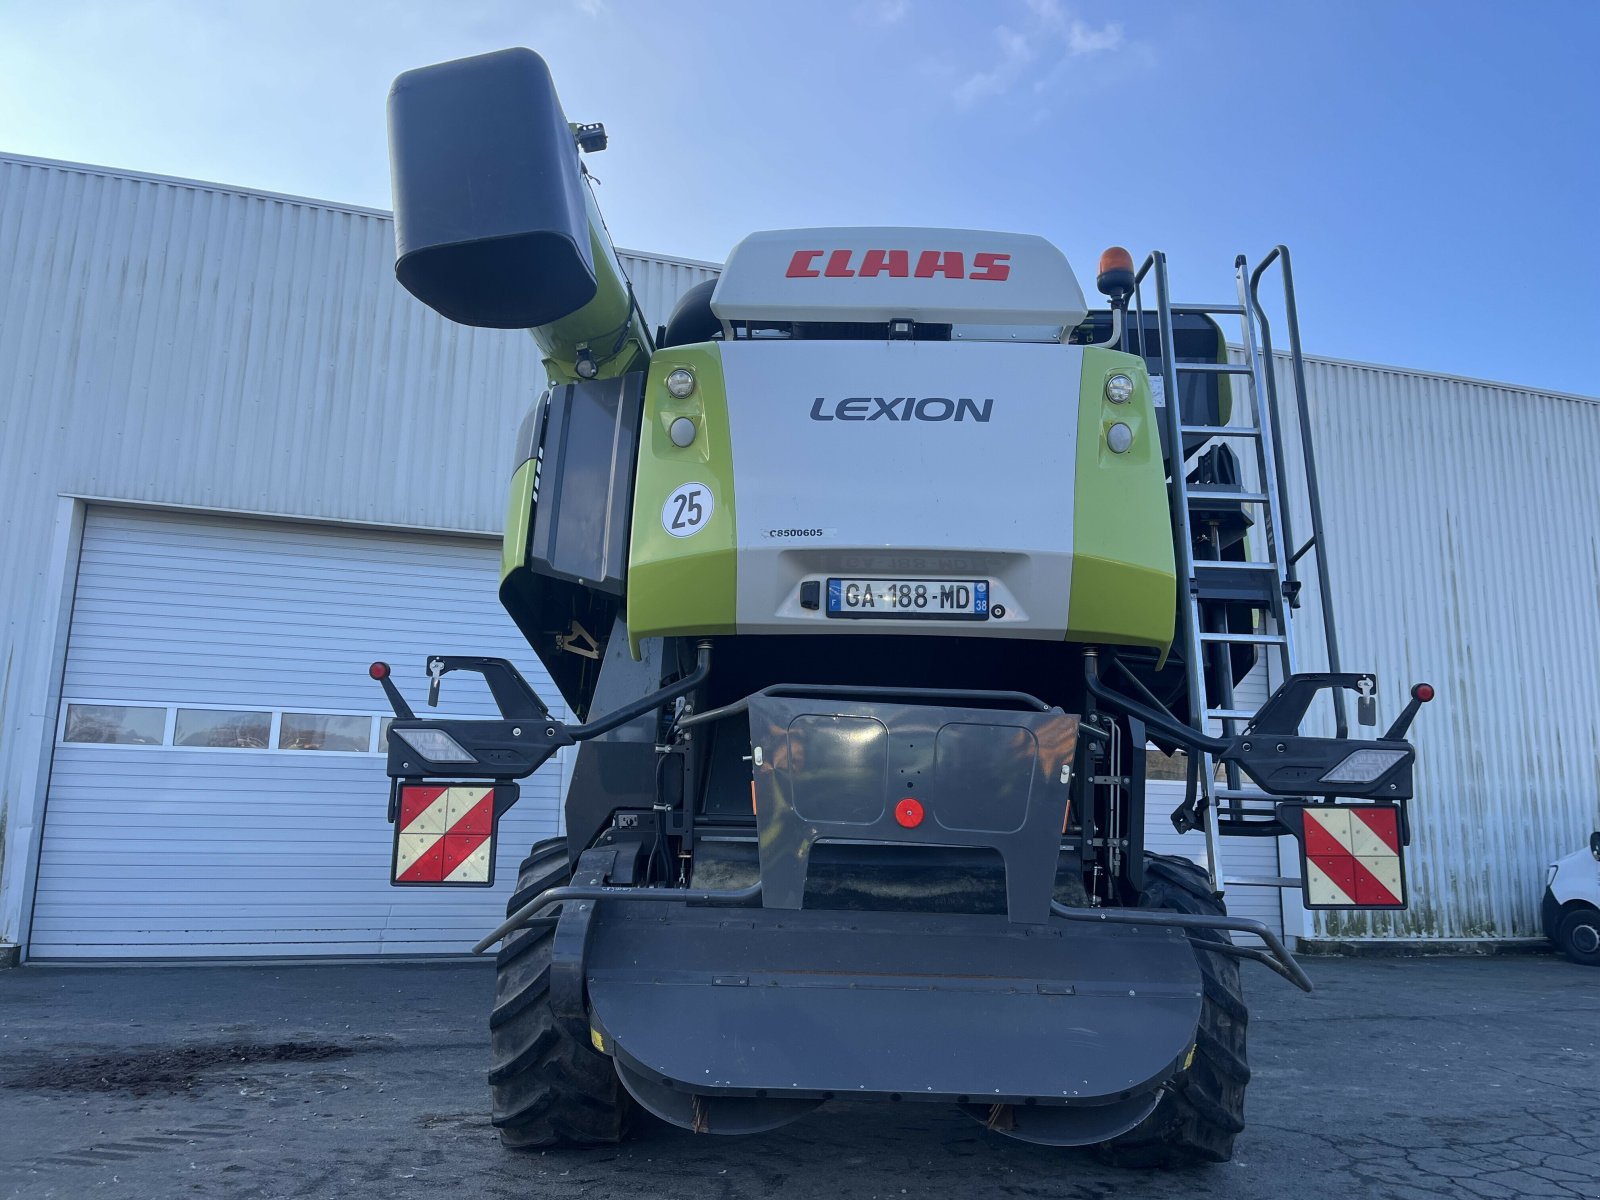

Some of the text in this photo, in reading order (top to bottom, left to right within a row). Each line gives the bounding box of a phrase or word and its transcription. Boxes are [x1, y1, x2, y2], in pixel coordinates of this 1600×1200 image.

[785, 250, 1011, 281] CLAAS
[809, 397, 994, 423] LEXION
[671, 490, 703, 530] 25
[769, 529, 823, 537] C8500605
[831, 599, 837, 607] F
[845, 583, 970, 609] GA-188-MD
[975, 600, 987, 611] 38
